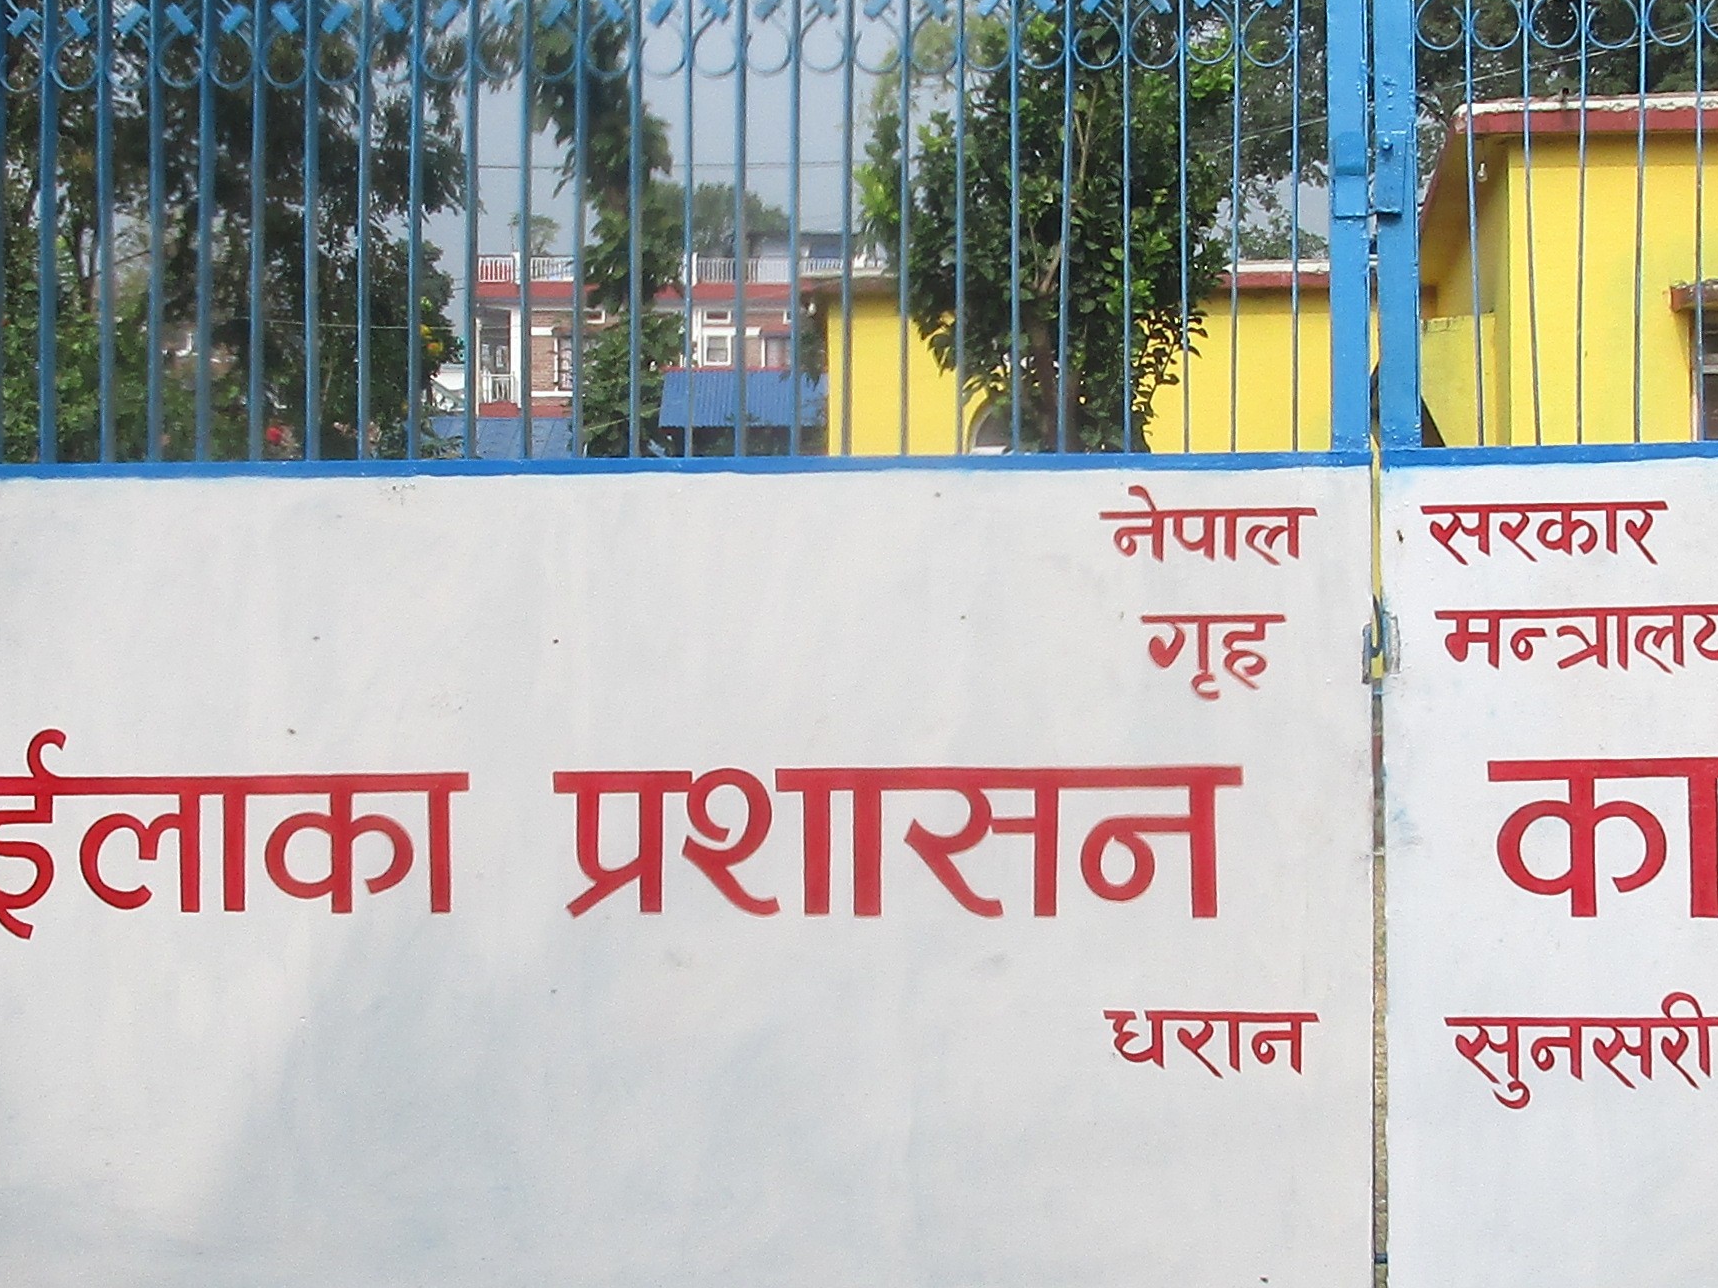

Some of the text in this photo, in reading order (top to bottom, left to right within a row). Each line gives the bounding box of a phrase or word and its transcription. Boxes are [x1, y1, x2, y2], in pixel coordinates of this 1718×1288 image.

[1100, 485, 1668, 565] नेपाल सरकार
[1141, 613, 1287, 701] गृह
[553, 765, 1244, 919] प्रशासन
[1104, 1009, 1320, 1077] धरान
